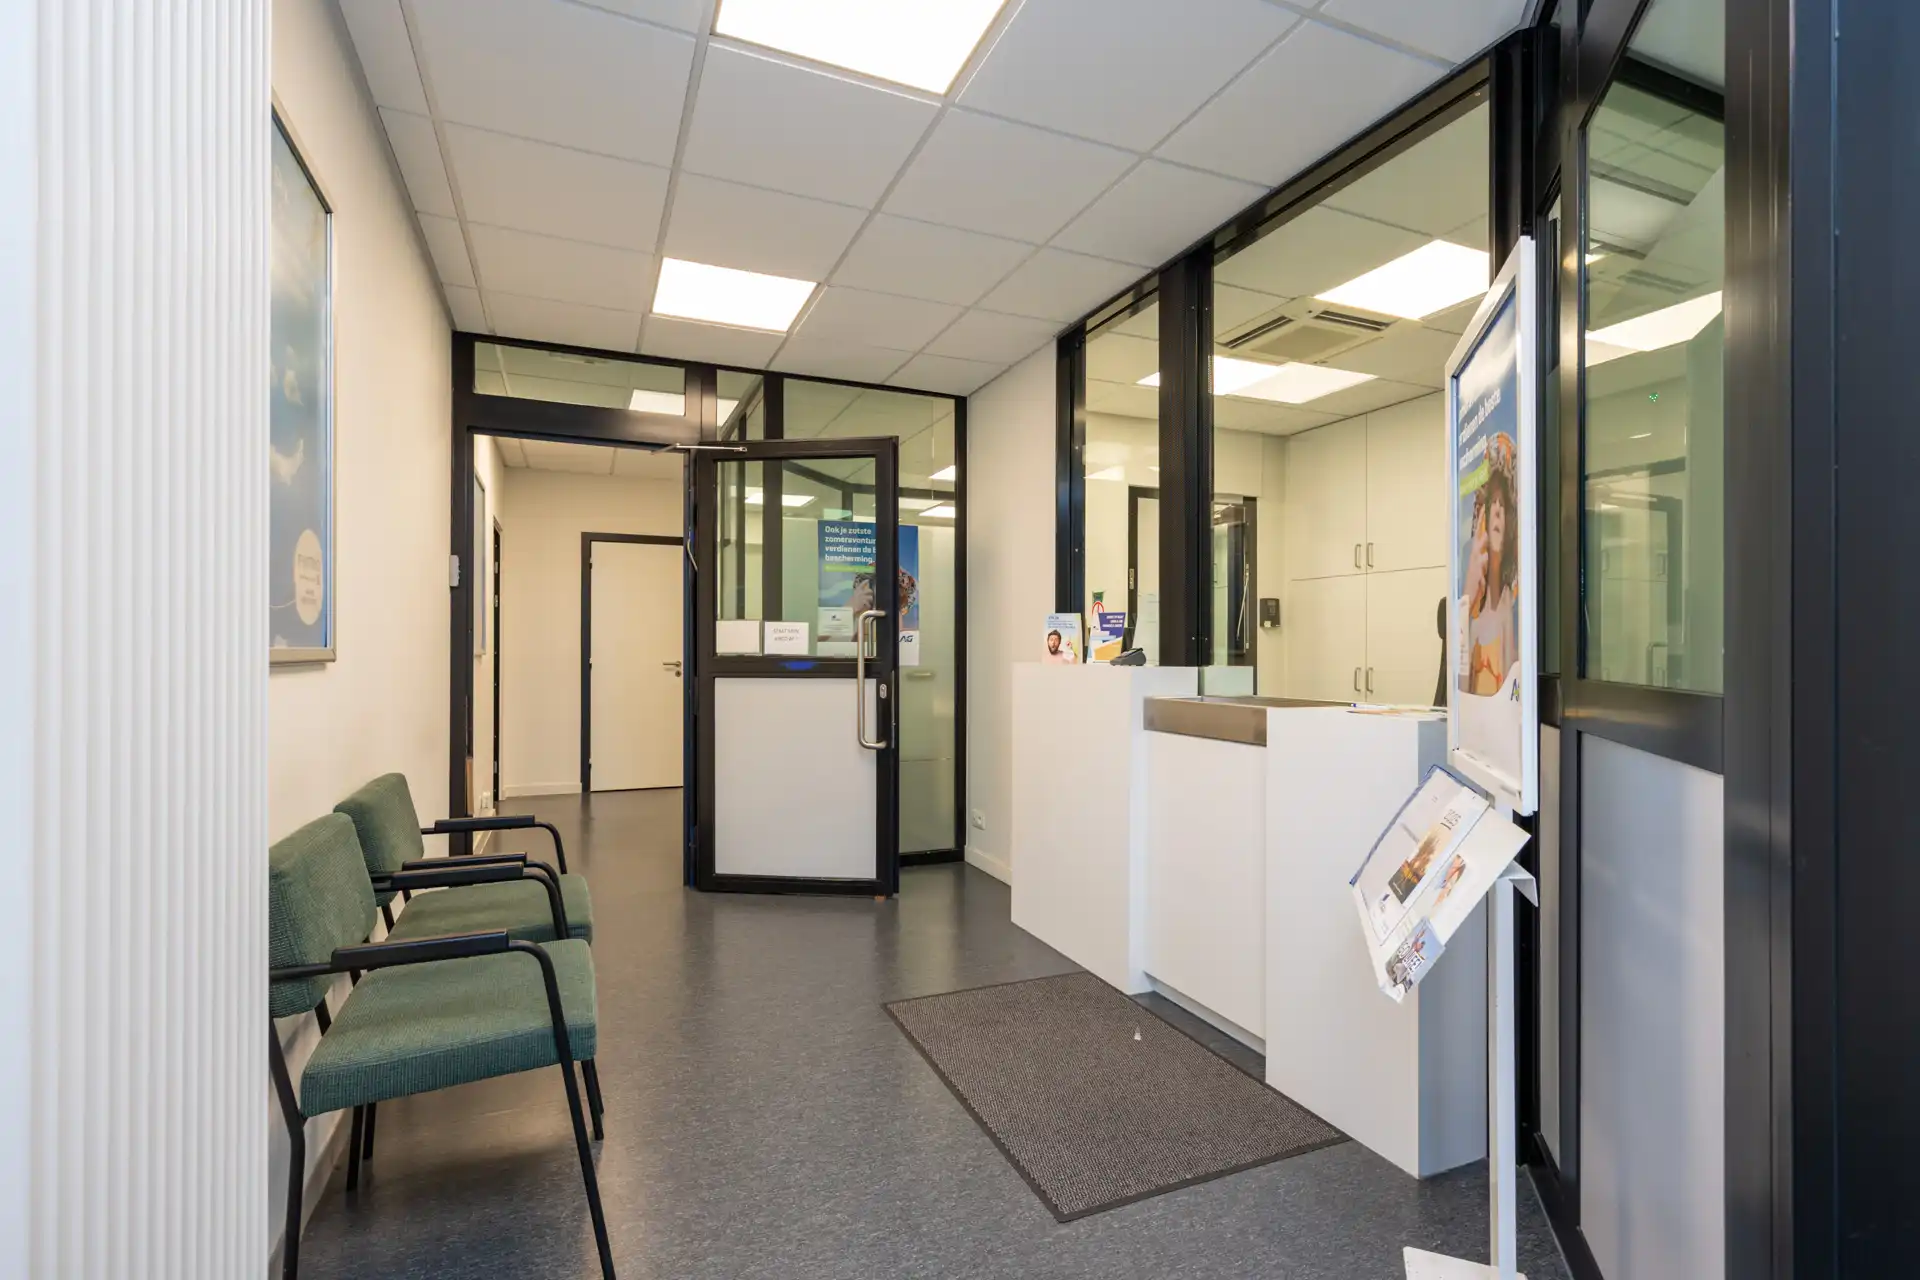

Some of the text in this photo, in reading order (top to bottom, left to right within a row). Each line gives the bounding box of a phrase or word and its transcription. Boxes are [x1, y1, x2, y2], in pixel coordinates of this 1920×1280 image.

[824, 525, 840, 533] Ook
[840, 527, 848, 536] je
[824, 545, 862, 553] verdienen
[862, 546, 872, 554] de
